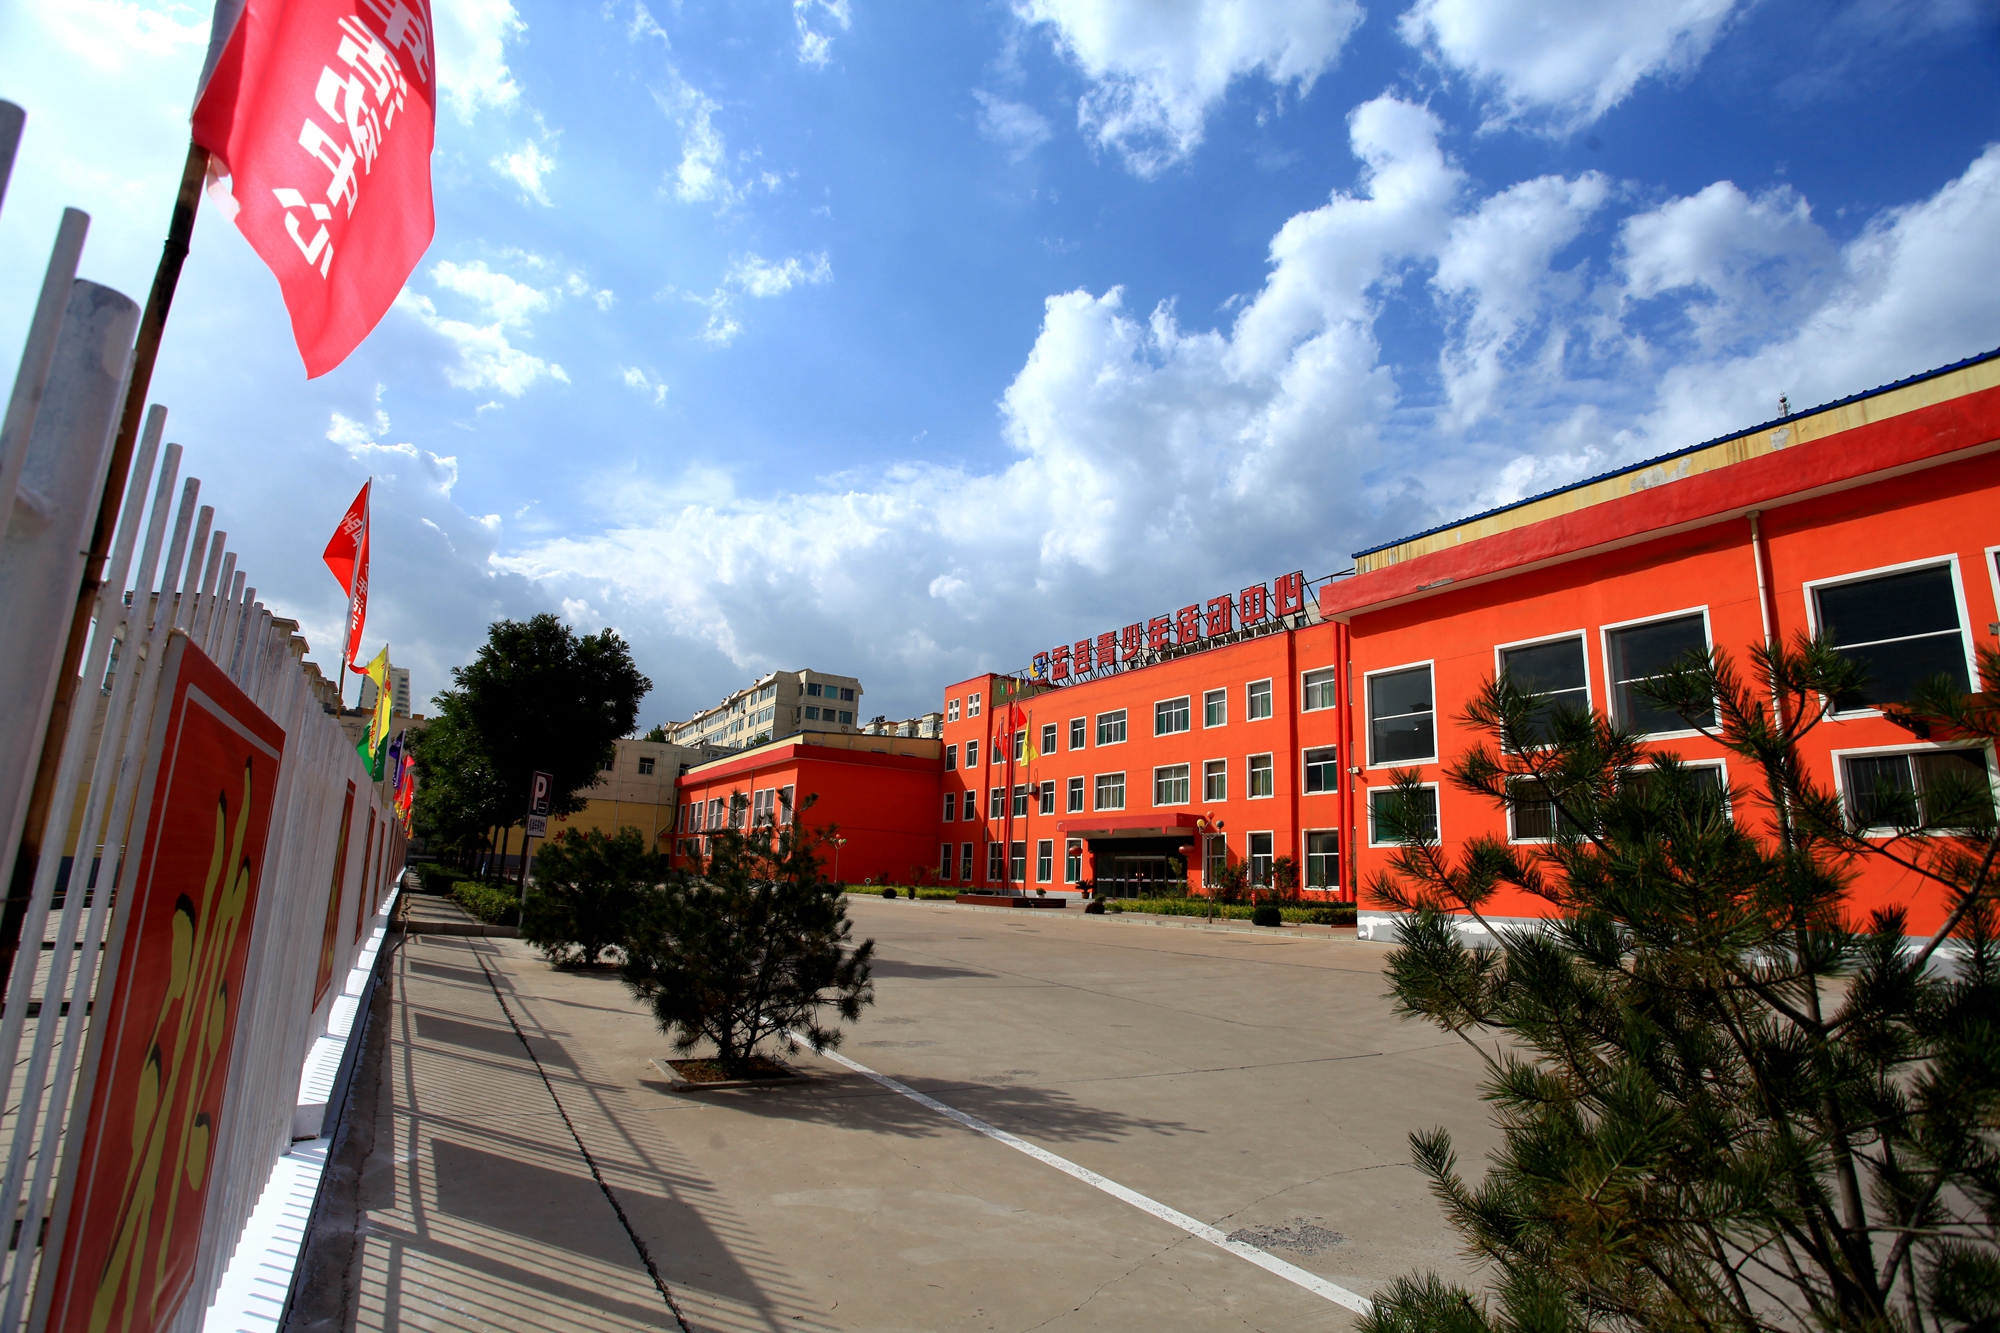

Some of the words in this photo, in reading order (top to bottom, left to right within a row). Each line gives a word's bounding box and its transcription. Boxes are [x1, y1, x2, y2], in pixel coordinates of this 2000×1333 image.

[1051, 571, 1304, 682] 盂县青少年活动中心
[532, 775, 548, 811] P
